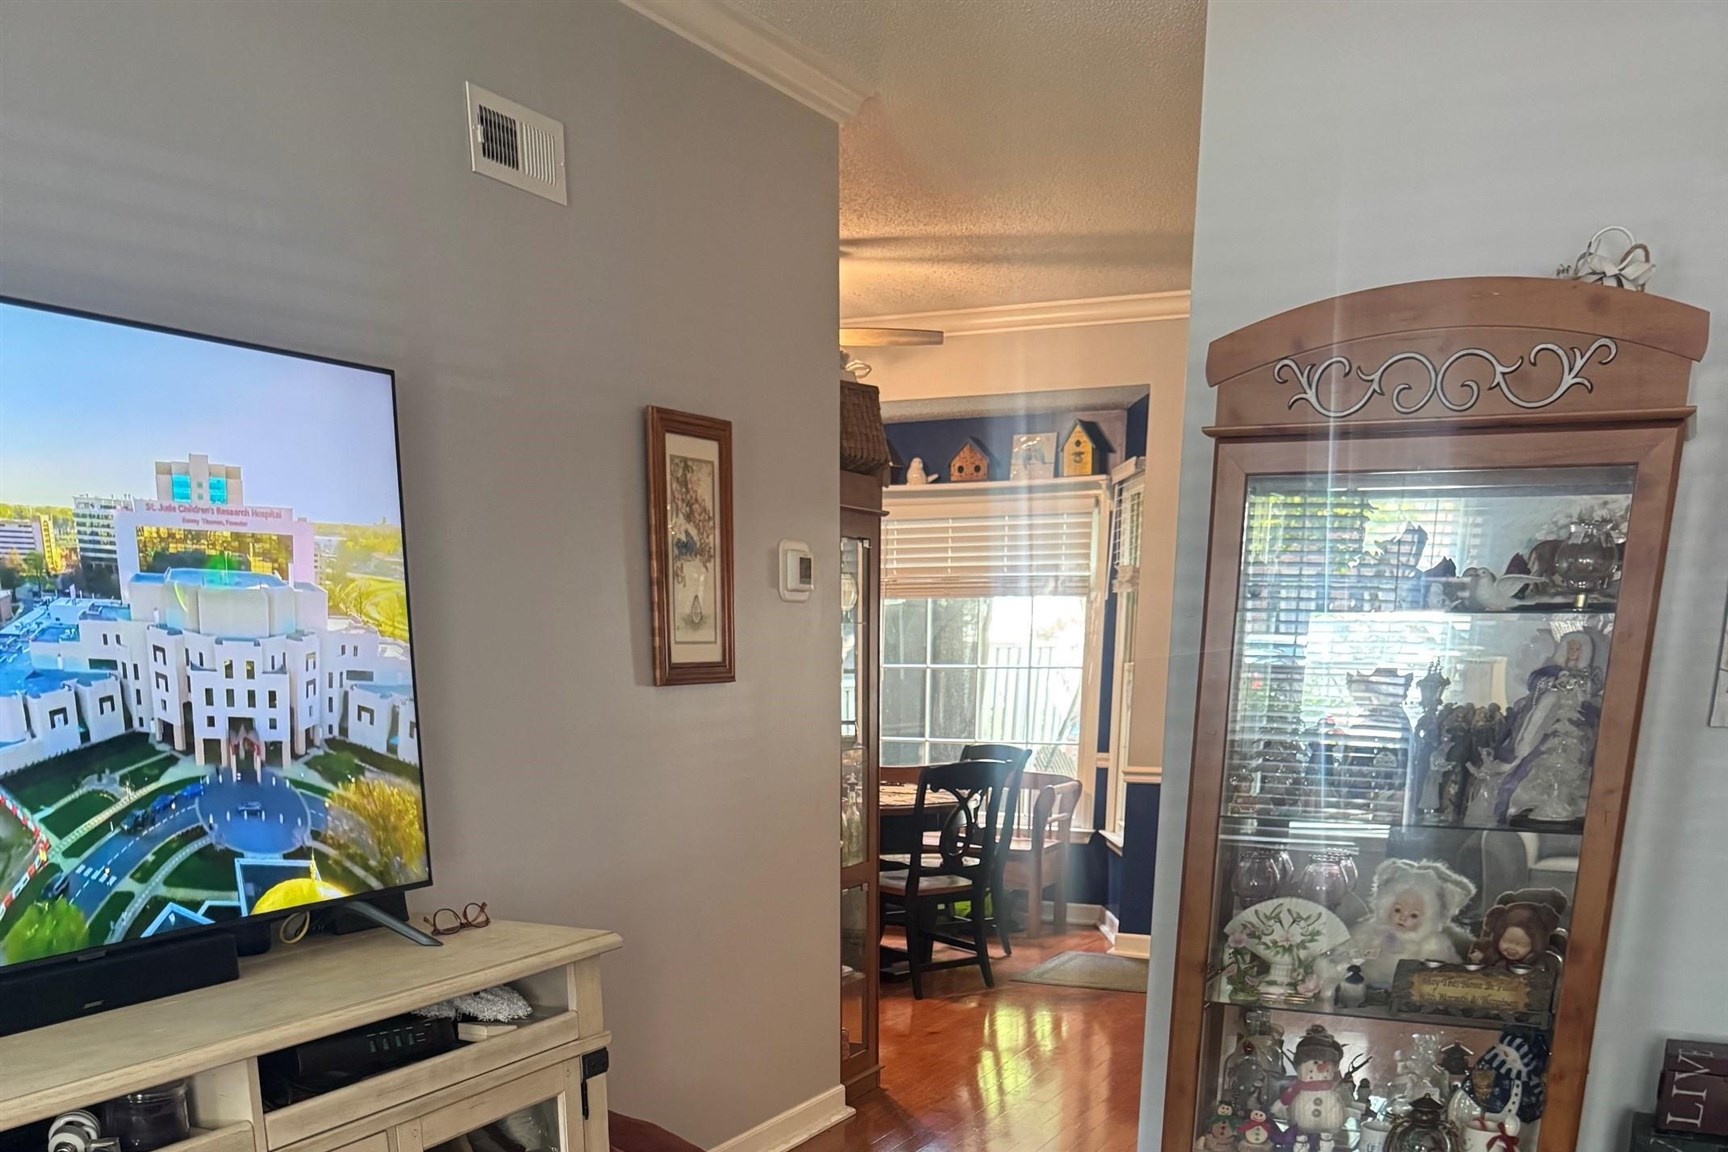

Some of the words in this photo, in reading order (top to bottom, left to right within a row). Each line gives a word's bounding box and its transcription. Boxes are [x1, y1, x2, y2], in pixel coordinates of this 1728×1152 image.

[178, 504, 214, 515] Children's
[216, 506, 249, 517] Research
[252, 508, 282, 520] Hospital
